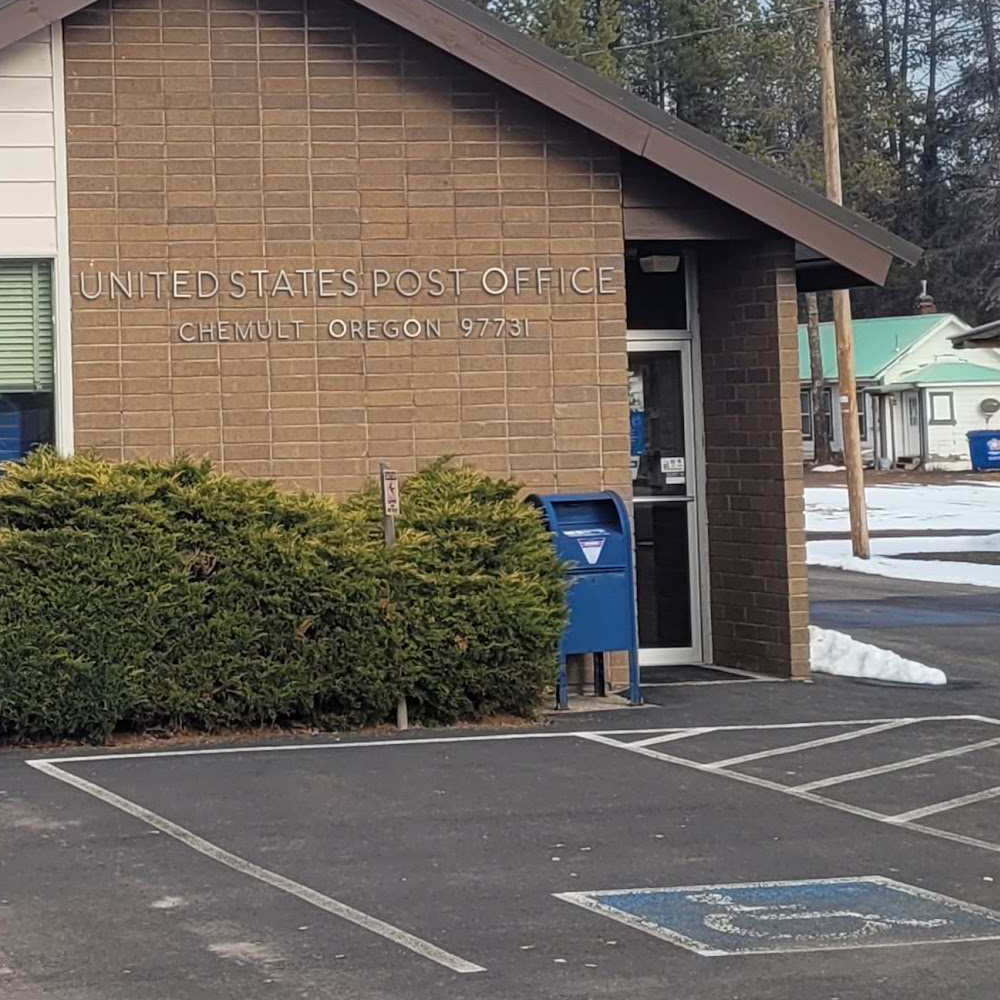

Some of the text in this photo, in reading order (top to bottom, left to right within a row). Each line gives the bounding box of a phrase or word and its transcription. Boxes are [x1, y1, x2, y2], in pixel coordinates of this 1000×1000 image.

[79, 266, 617, 300] UNITED STATES POST OFFICE
[178, 317, 530, 341] CHEMULT OREGON 97731
